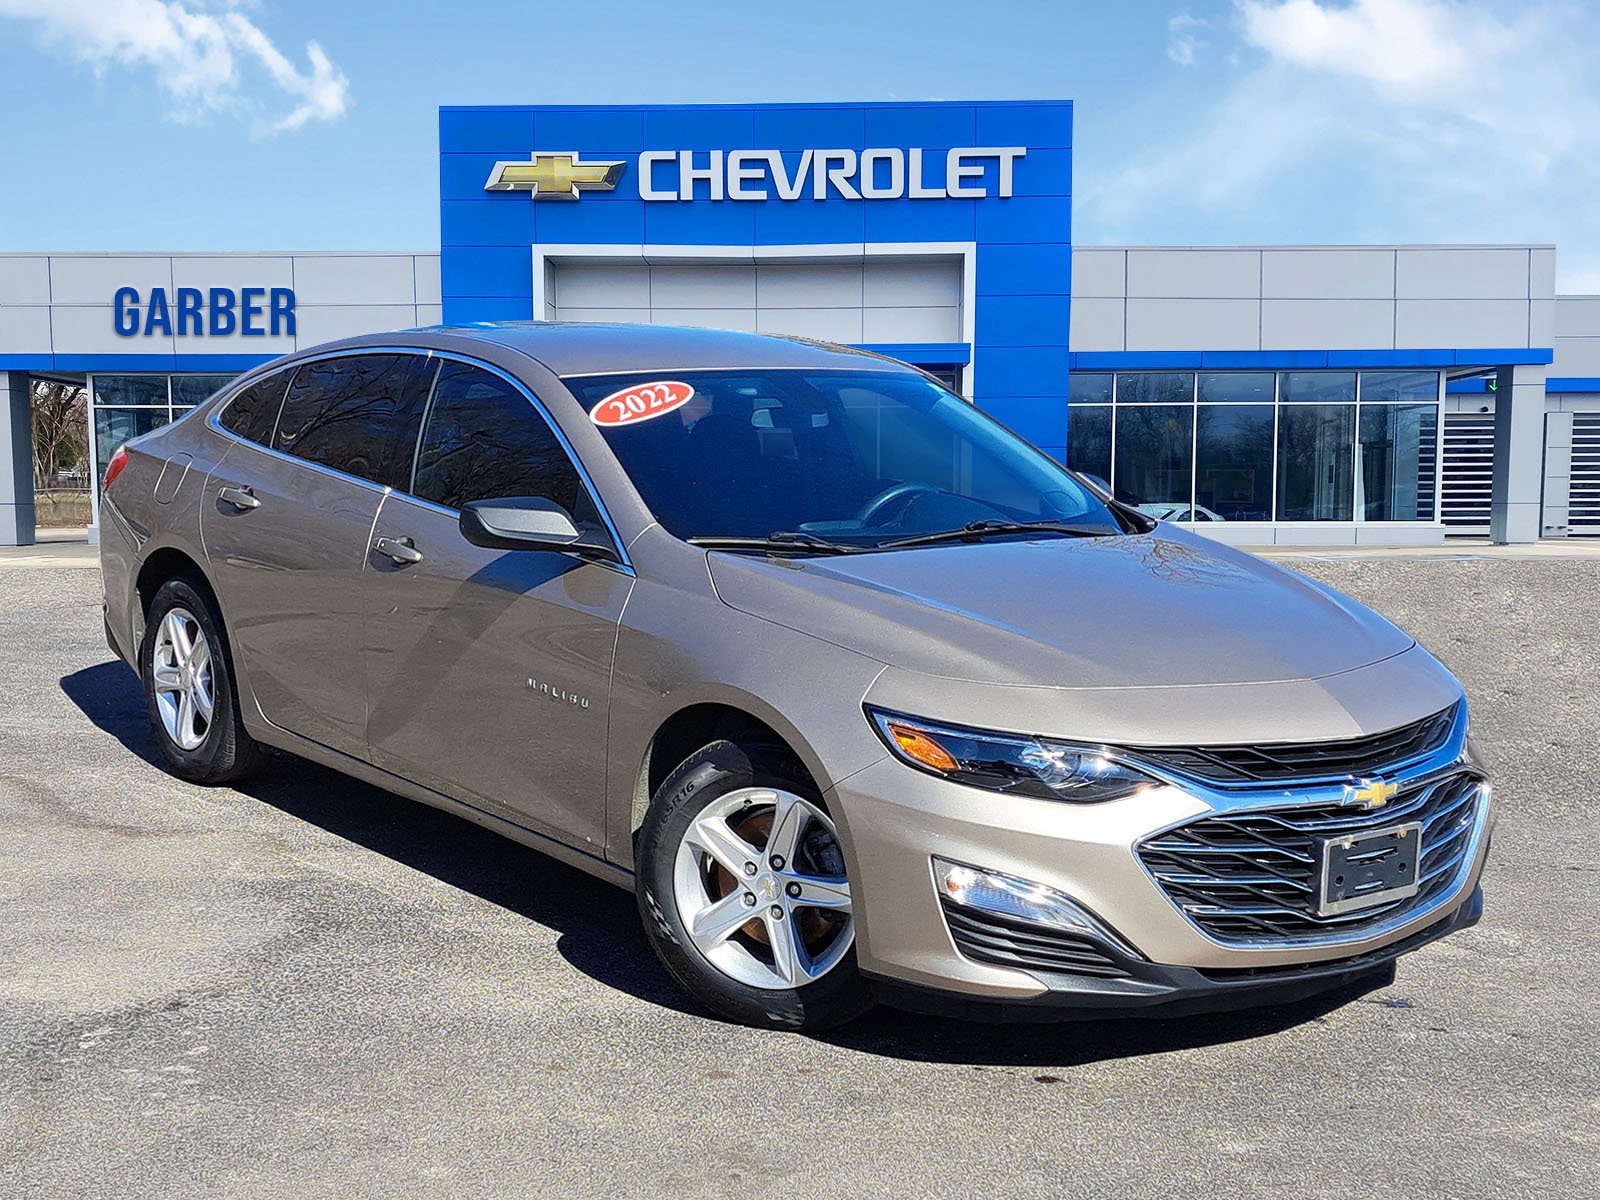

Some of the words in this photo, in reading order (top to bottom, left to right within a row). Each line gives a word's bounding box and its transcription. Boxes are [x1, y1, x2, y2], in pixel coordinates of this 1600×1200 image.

[638, 146, 1027, 201] CHEVROLET
[114, 286, 296, 336] GARBER
[609, 384, 677, 421] 2022
[527, 677, 590, 708] MALIBU
